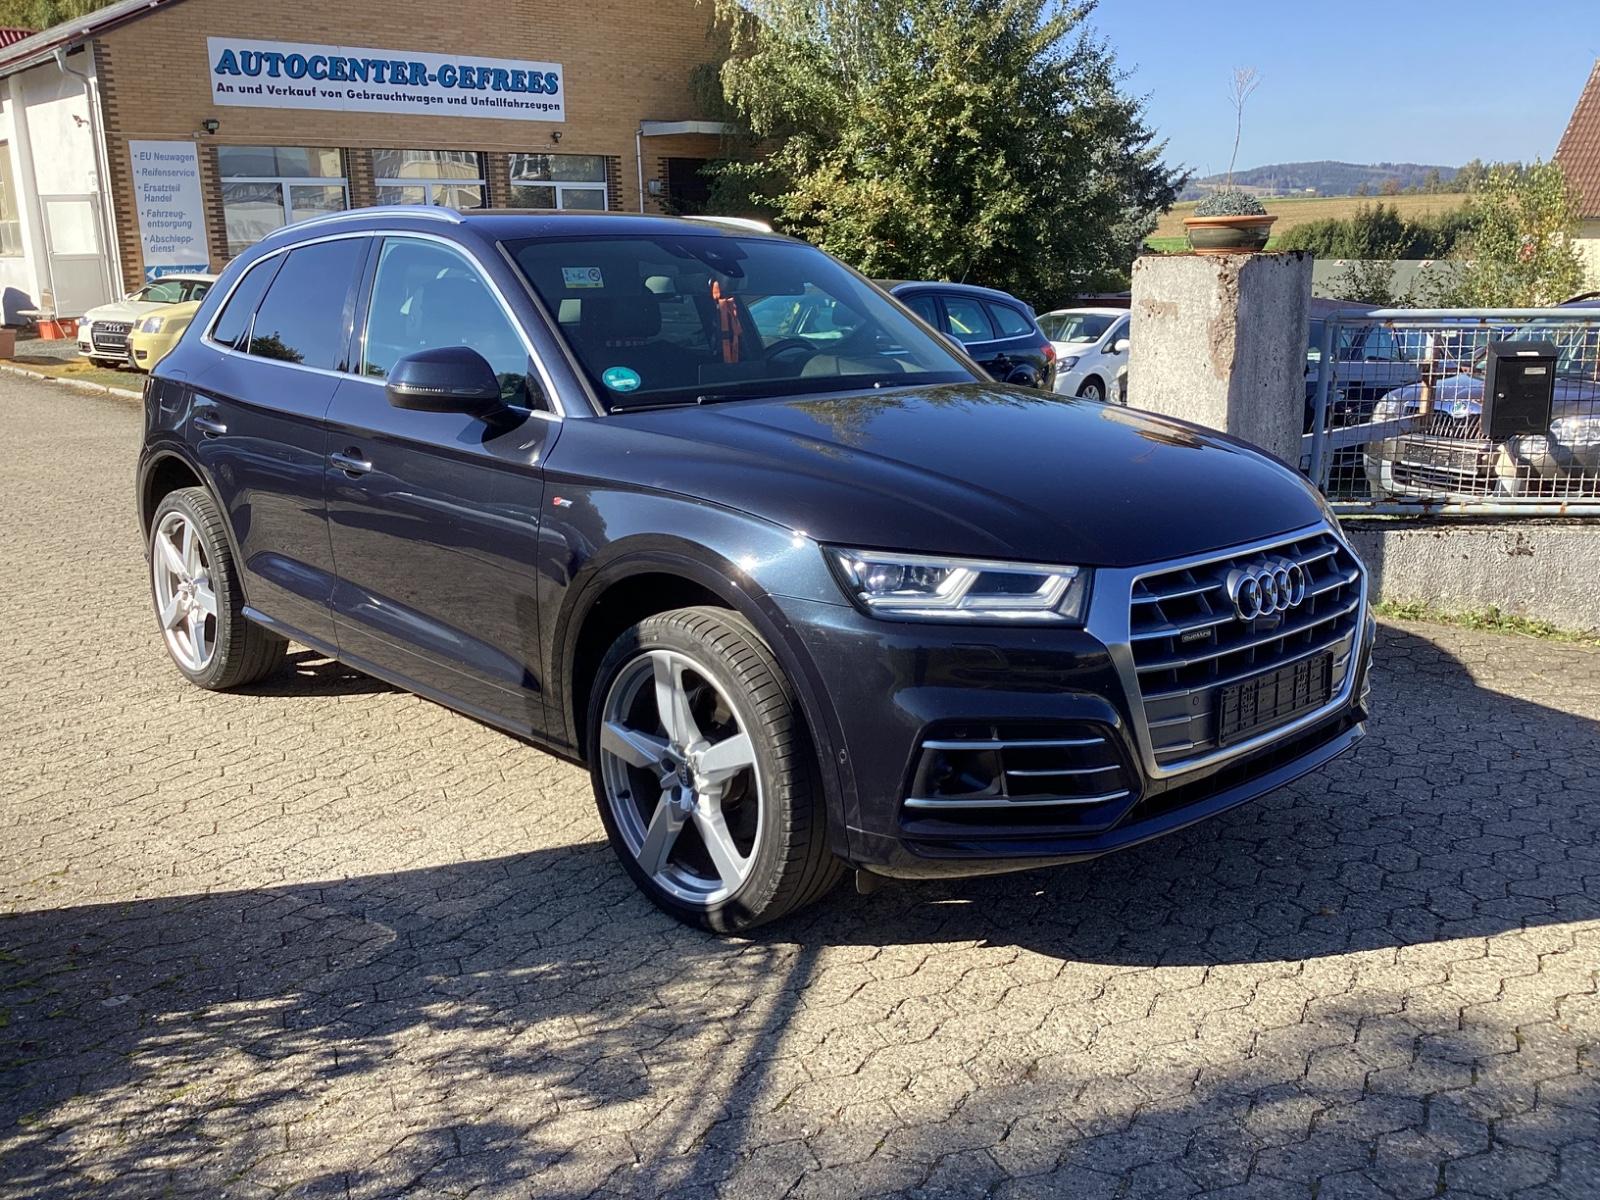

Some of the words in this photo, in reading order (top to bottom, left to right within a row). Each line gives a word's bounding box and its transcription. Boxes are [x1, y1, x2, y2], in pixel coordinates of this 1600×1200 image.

[214, 48, 559, 95] AUTOCENTER-GEFREES
[216, 82, 234, 93] An
[238, 84, 263, 94] und
[266, 85, 317, 97] Verkauf
[320, 89, 342, 98] von
[346, 89, 444, 105] Gebrauchtwagen
[447, 95, 468, 105] und
[471, 96, 561, 112] Unfallfahrzeugen
[140, 152, 152, 161] EU
[154, 152, 195, 163] Neuwagen
[141, 168, 195, 177] Reifenservice
[143, 183, 180, 192] Ersatzteil
[144, 194, 172, 203] Handel
[146, 209, 186, 219] Fahrzeug-
[147, 219, 192, 229] entsorgung
[149, 234, 194, 245] Abschlepp-
[150, 244, 175, 253] dienst
